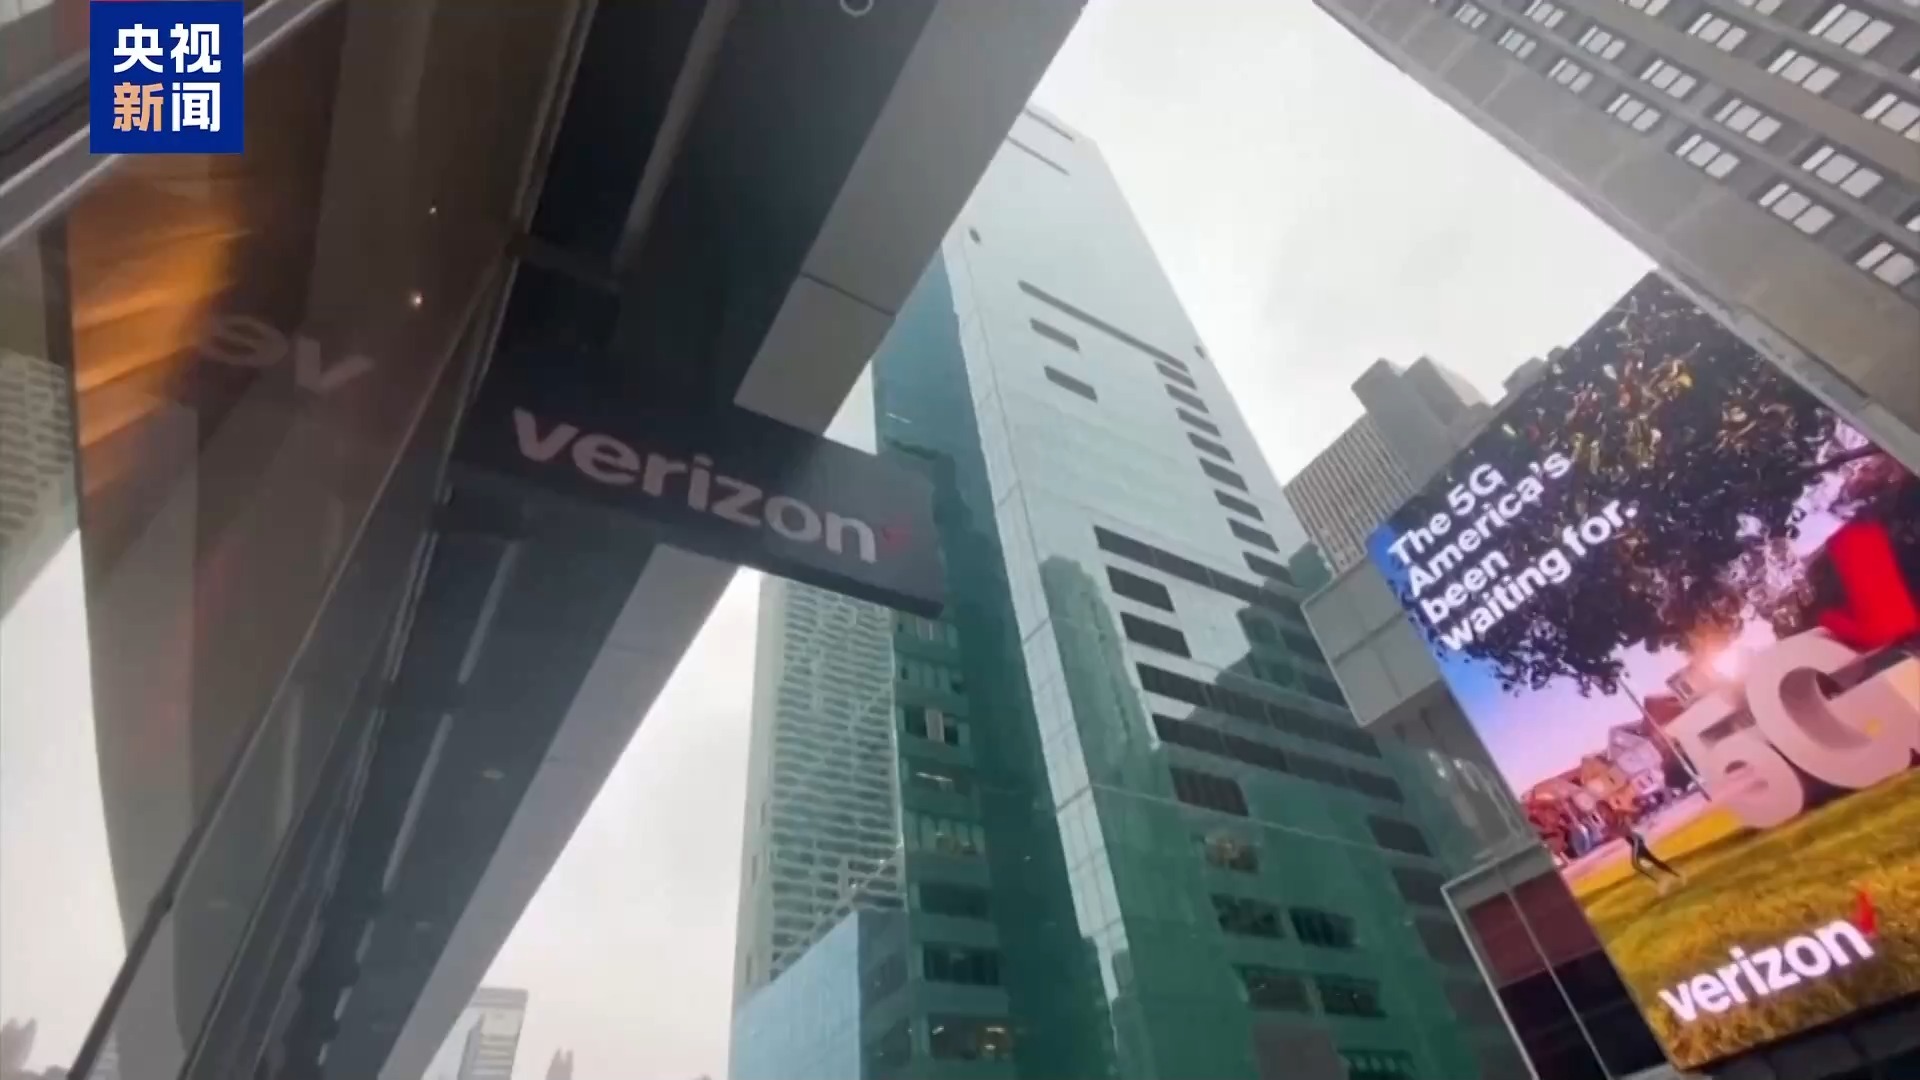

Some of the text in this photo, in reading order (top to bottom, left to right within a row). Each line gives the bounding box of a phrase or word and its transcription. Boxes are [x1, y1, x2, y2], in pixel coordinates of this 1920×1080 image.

[513, 407, 880, 563] verizon
[1387, 463, 1505, 563] The 5G
[1408, 452, 1571, 598] America's
[1420, 550, 1509, 623] been
[1440, 500, 1637, 650] waiting for.
[1664, 627, 1920, 828] 5G
[1658, 918, 1874, 1021] verizon
